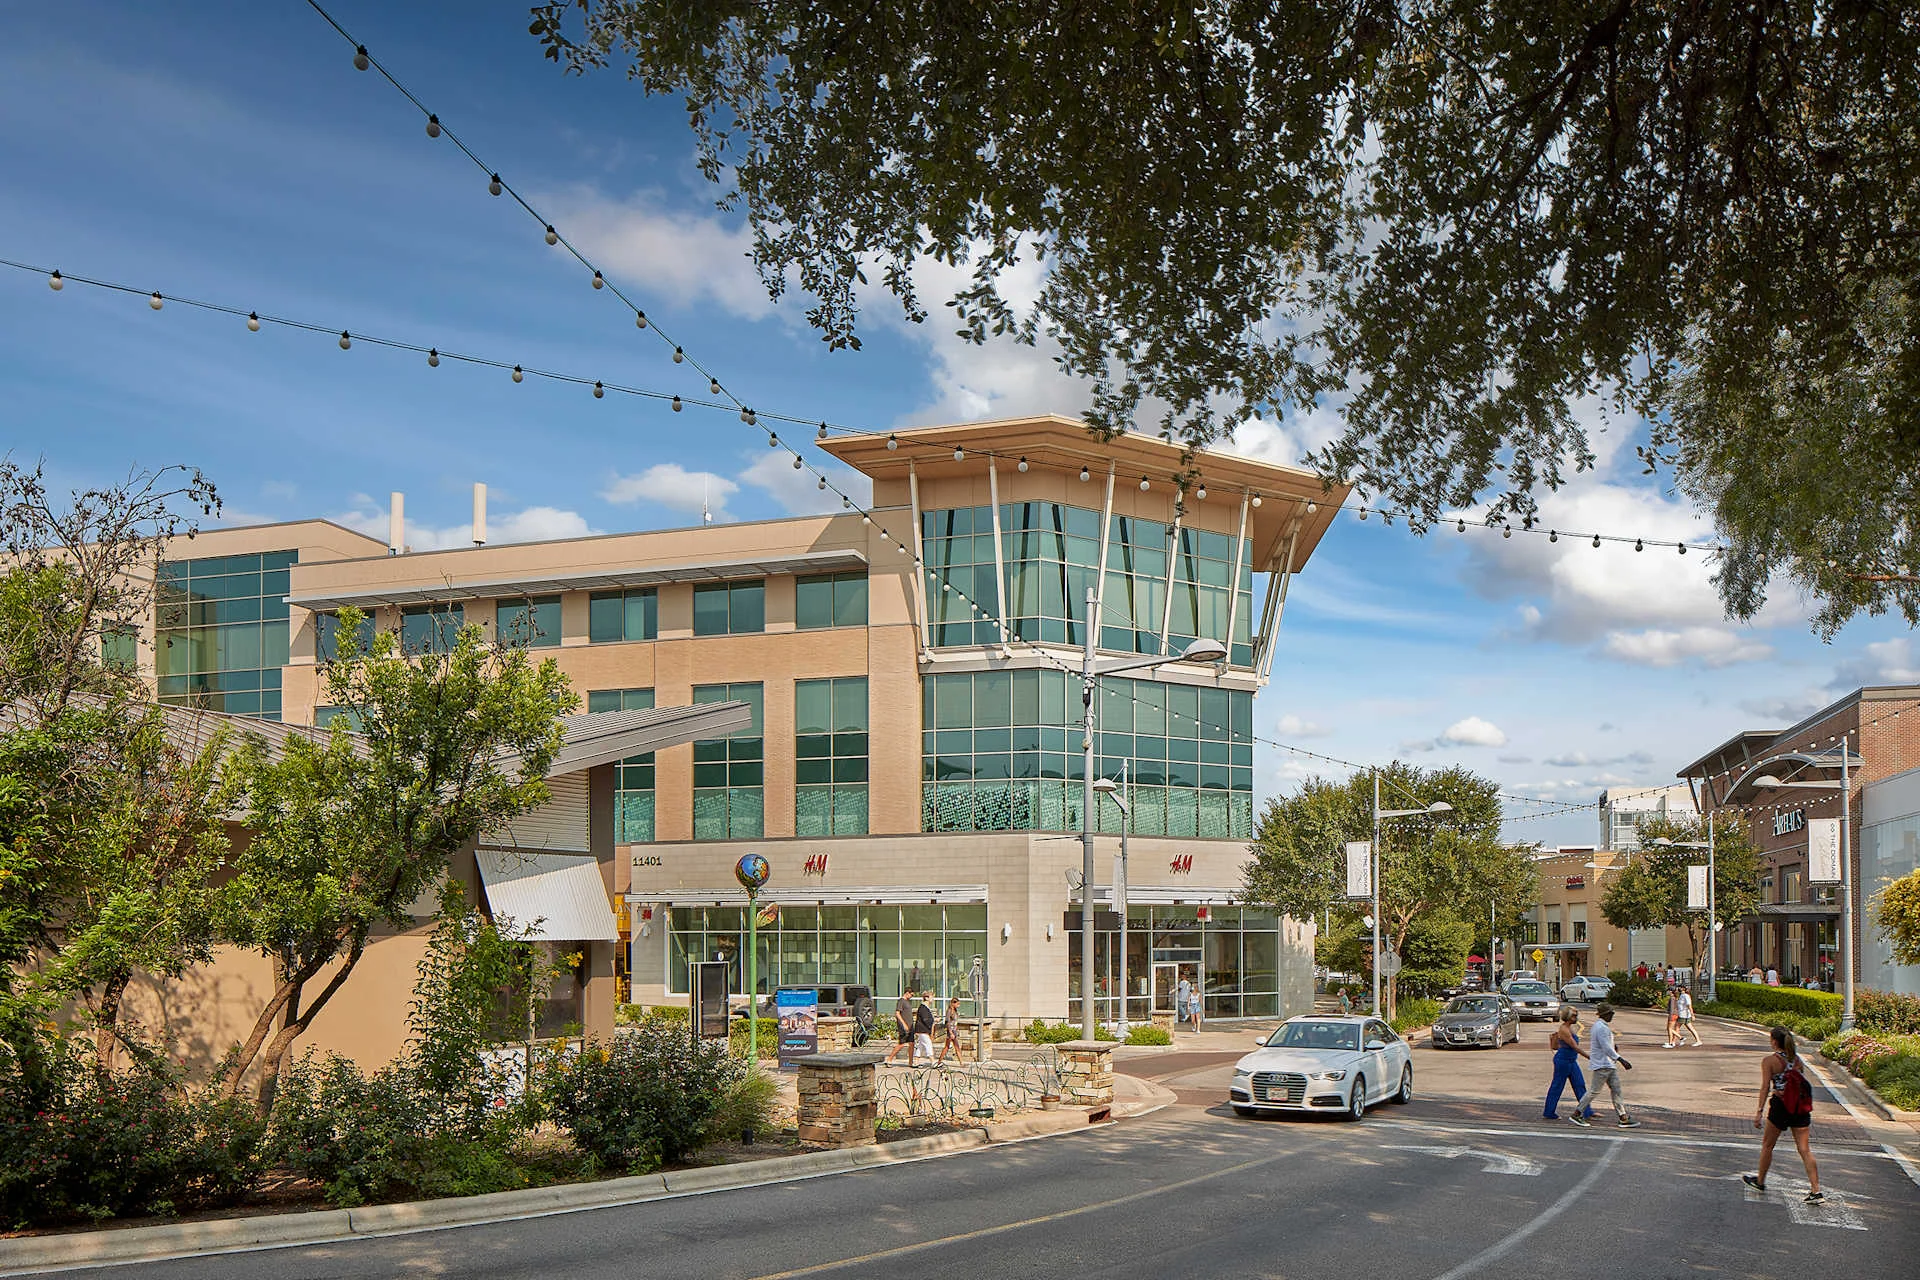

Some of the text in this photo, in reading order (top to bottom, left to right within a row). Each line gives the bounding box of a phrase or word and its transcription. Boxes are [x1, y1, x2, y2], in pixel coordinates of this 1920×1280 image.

[632, 856, 662, 866] 11401
[804, 854, 828, 872] H&M
[1170, 854, 1193, 872] H&M
